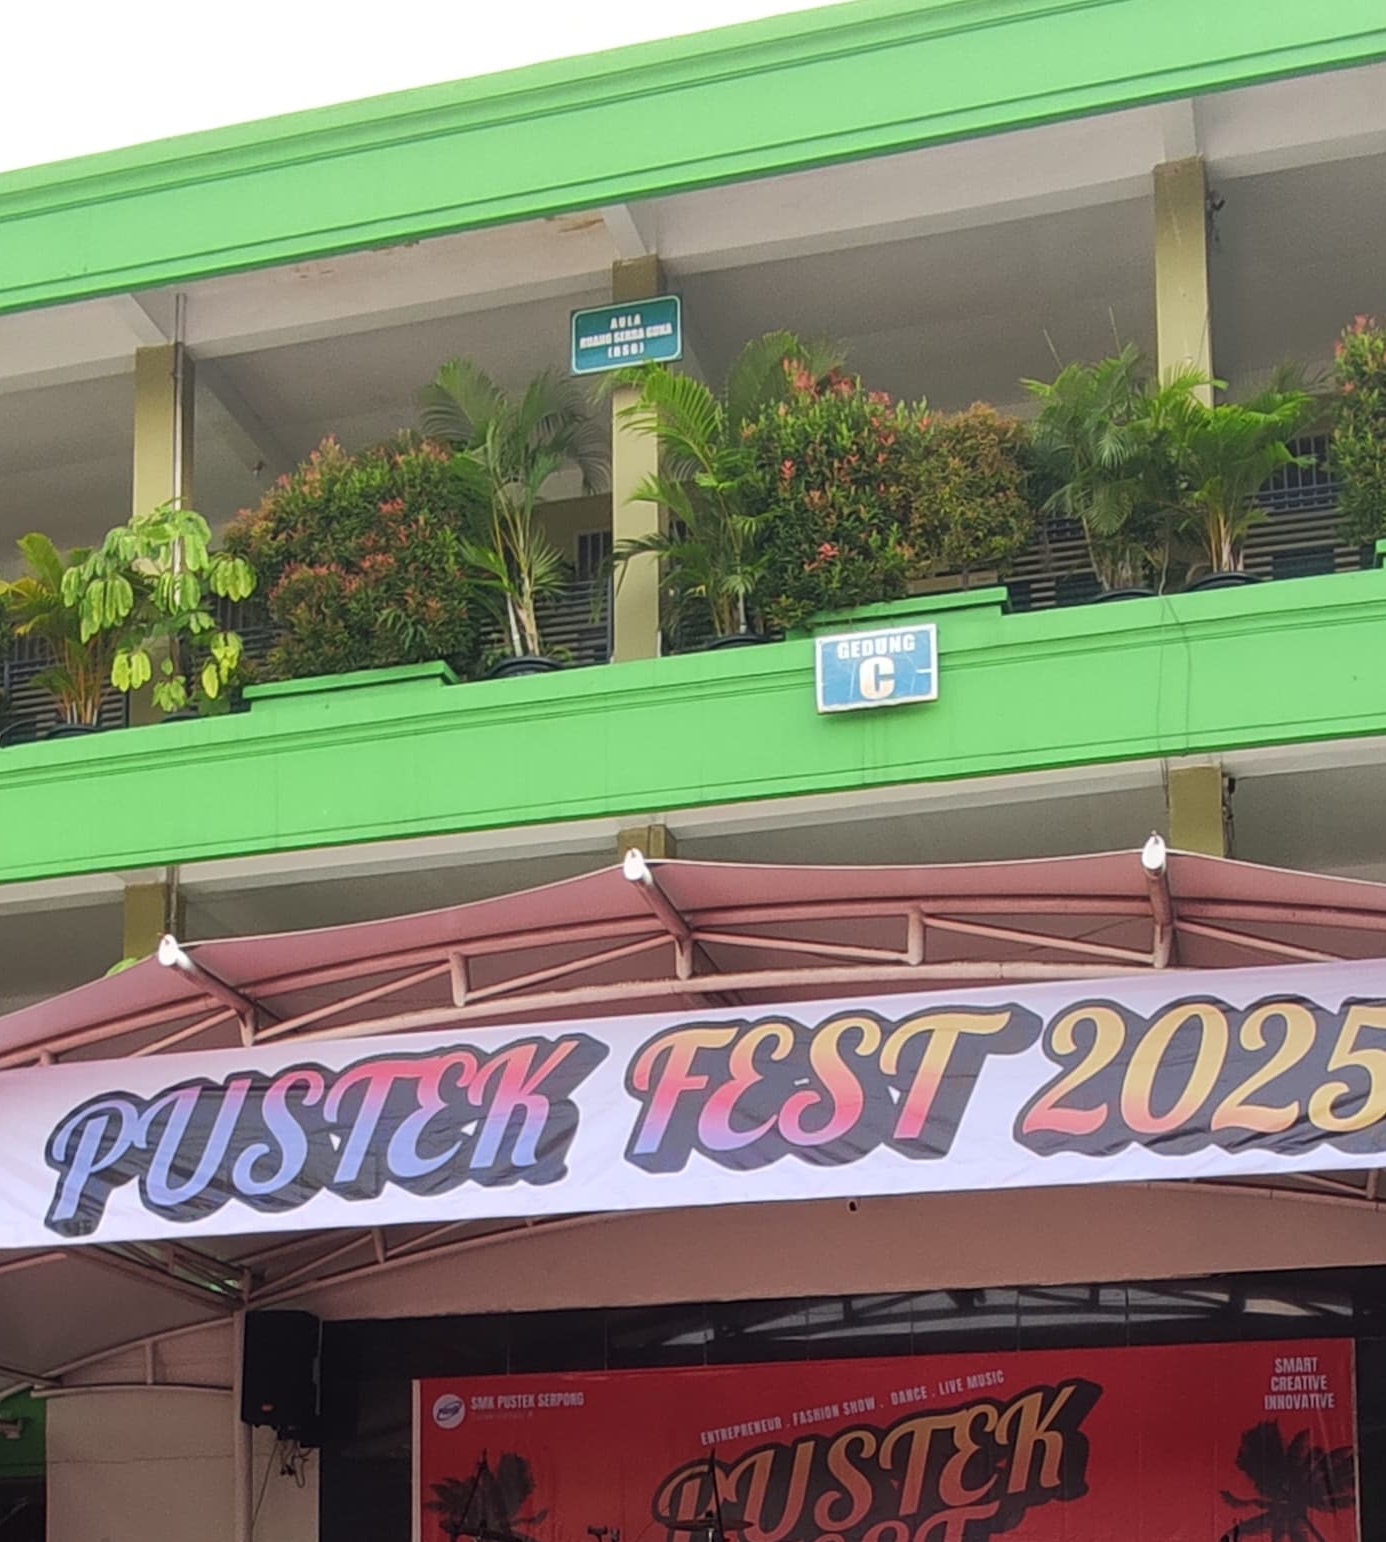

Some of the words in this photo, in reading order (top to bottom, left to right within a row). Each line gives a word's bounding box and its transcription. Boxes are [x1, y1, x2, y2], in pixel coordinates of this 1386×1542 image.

[610, 313, 642, 331] AULA
[837, 633, 916, 660] GEDUNG
[859, 656, 895, 700] C
[49, 1034, 598, 1236] PUSTEK
[625, 1003, 1028, 1165] FEST
[1274, 1356, 1318, 1374] SMART
[1270, 1374, 1328, 1392] CREATIVE
[470, 1396, 494, 1411] SMK
[497, 1394, 535, 1409] PUSTEK
[700, 1416, 782, 1446] ENTREPRENEUR
[792, 1404, 840, 1426] FASHION
[842, 1396, 875, 1416] SHOW
[890, 1385, 928, 1406] DANCE
[938, 1378, 964, 1396] LIVE
[966, 1369, 1005, 1390] MUSIC
[1264, 1392, 1335, 1411] INNOVATIVE
